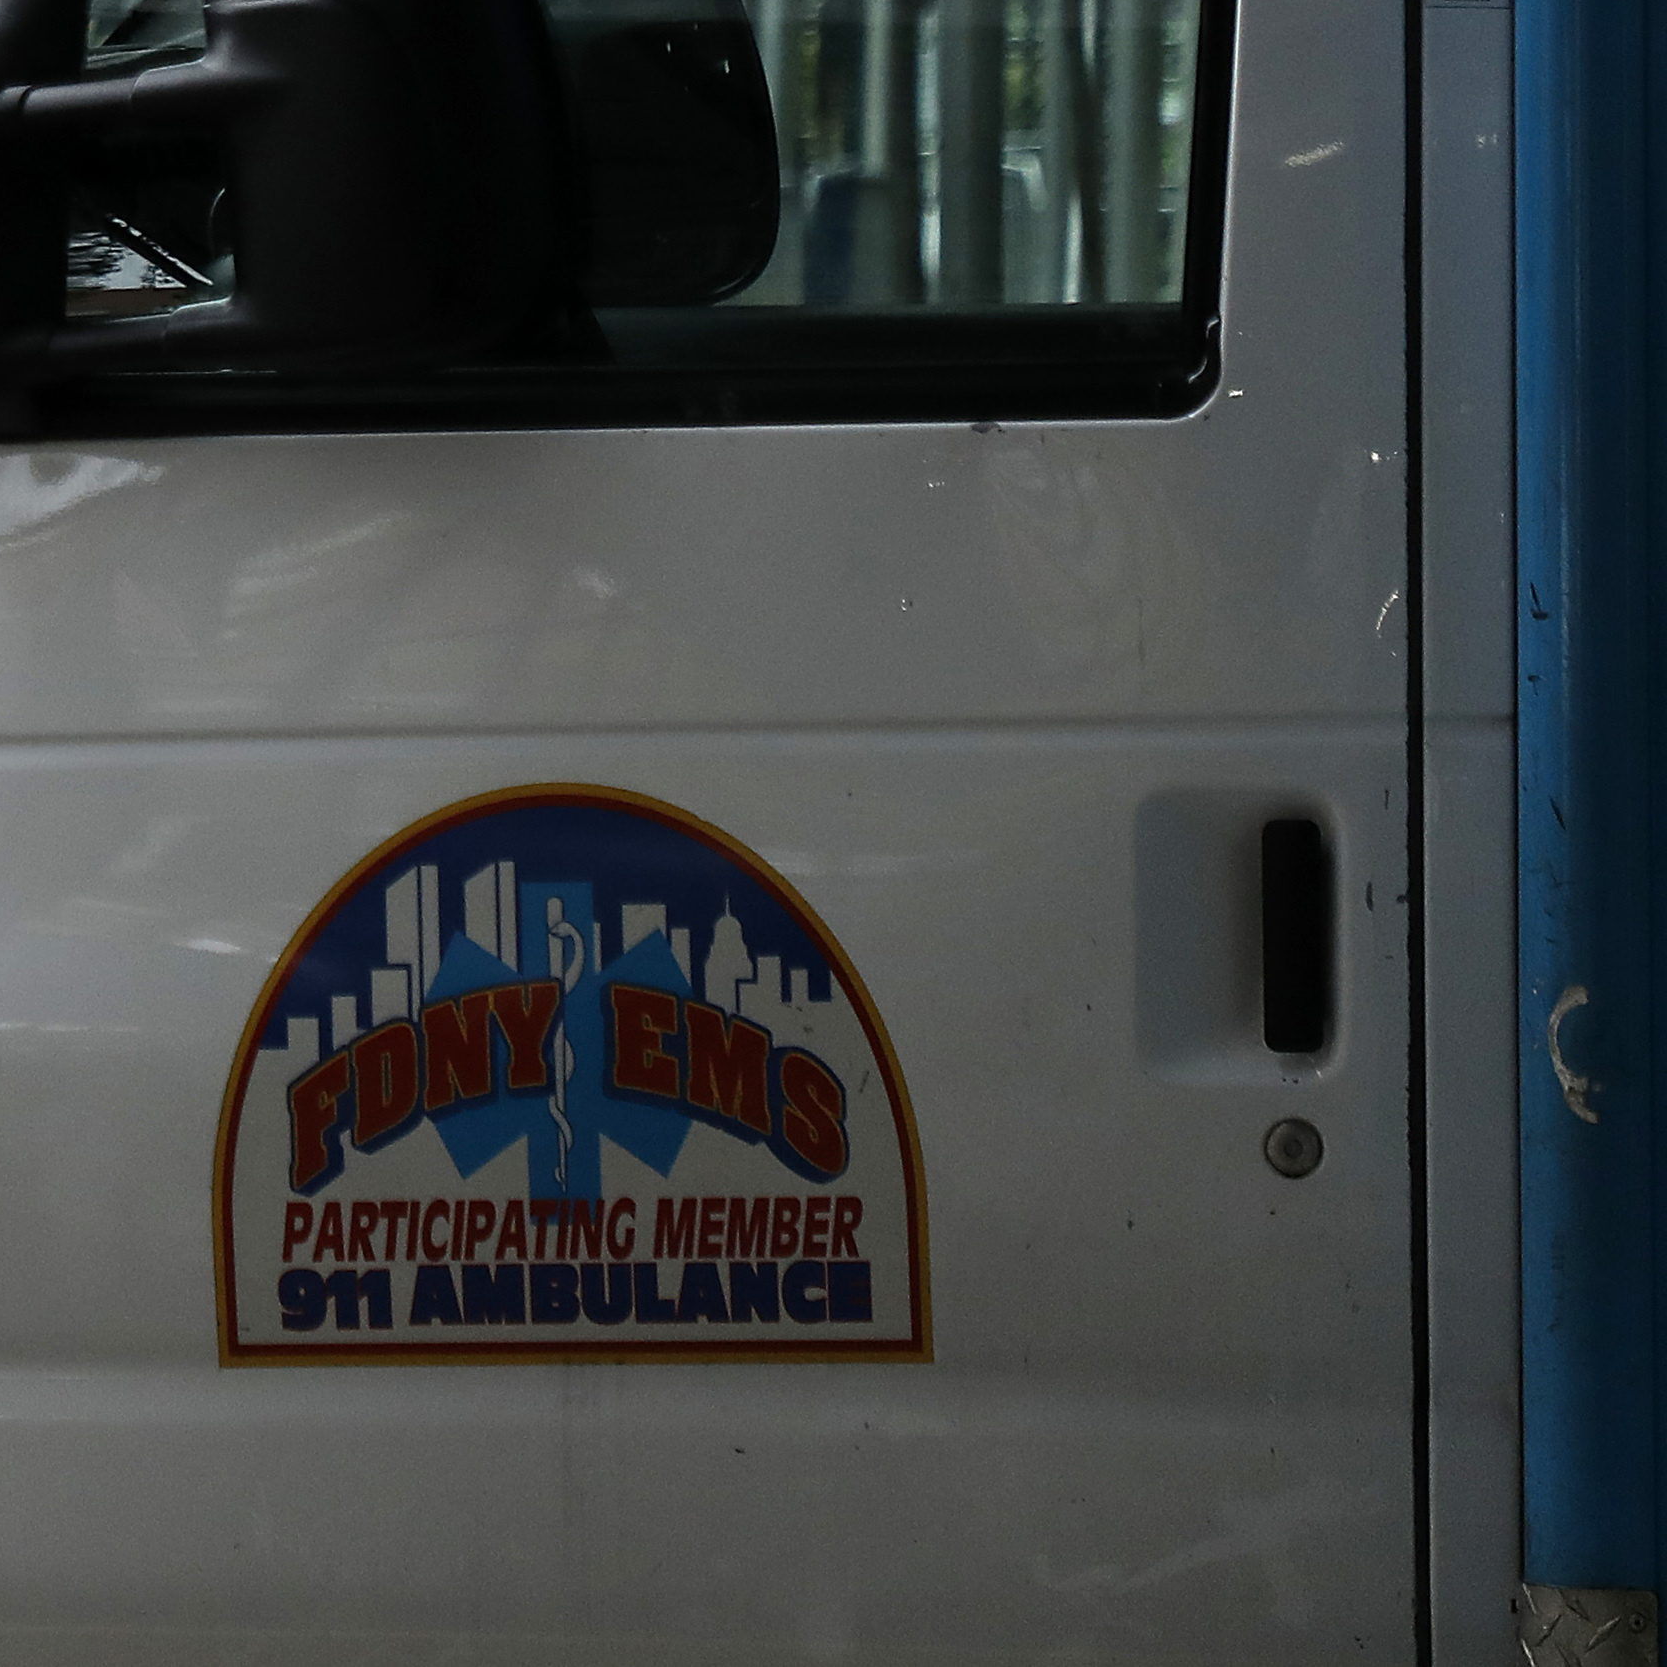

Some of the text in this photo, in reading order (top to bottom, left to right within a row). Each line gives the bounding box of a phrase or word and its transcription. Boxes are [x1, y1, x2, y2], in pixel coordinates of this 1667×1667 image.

[287, 979, 850, 1196] FDNY EMS
[281, 1194, 866, 1263] PARTICIPATING MEMBER
[277, 1258, 874, 1331] 911 AMBULANCE
